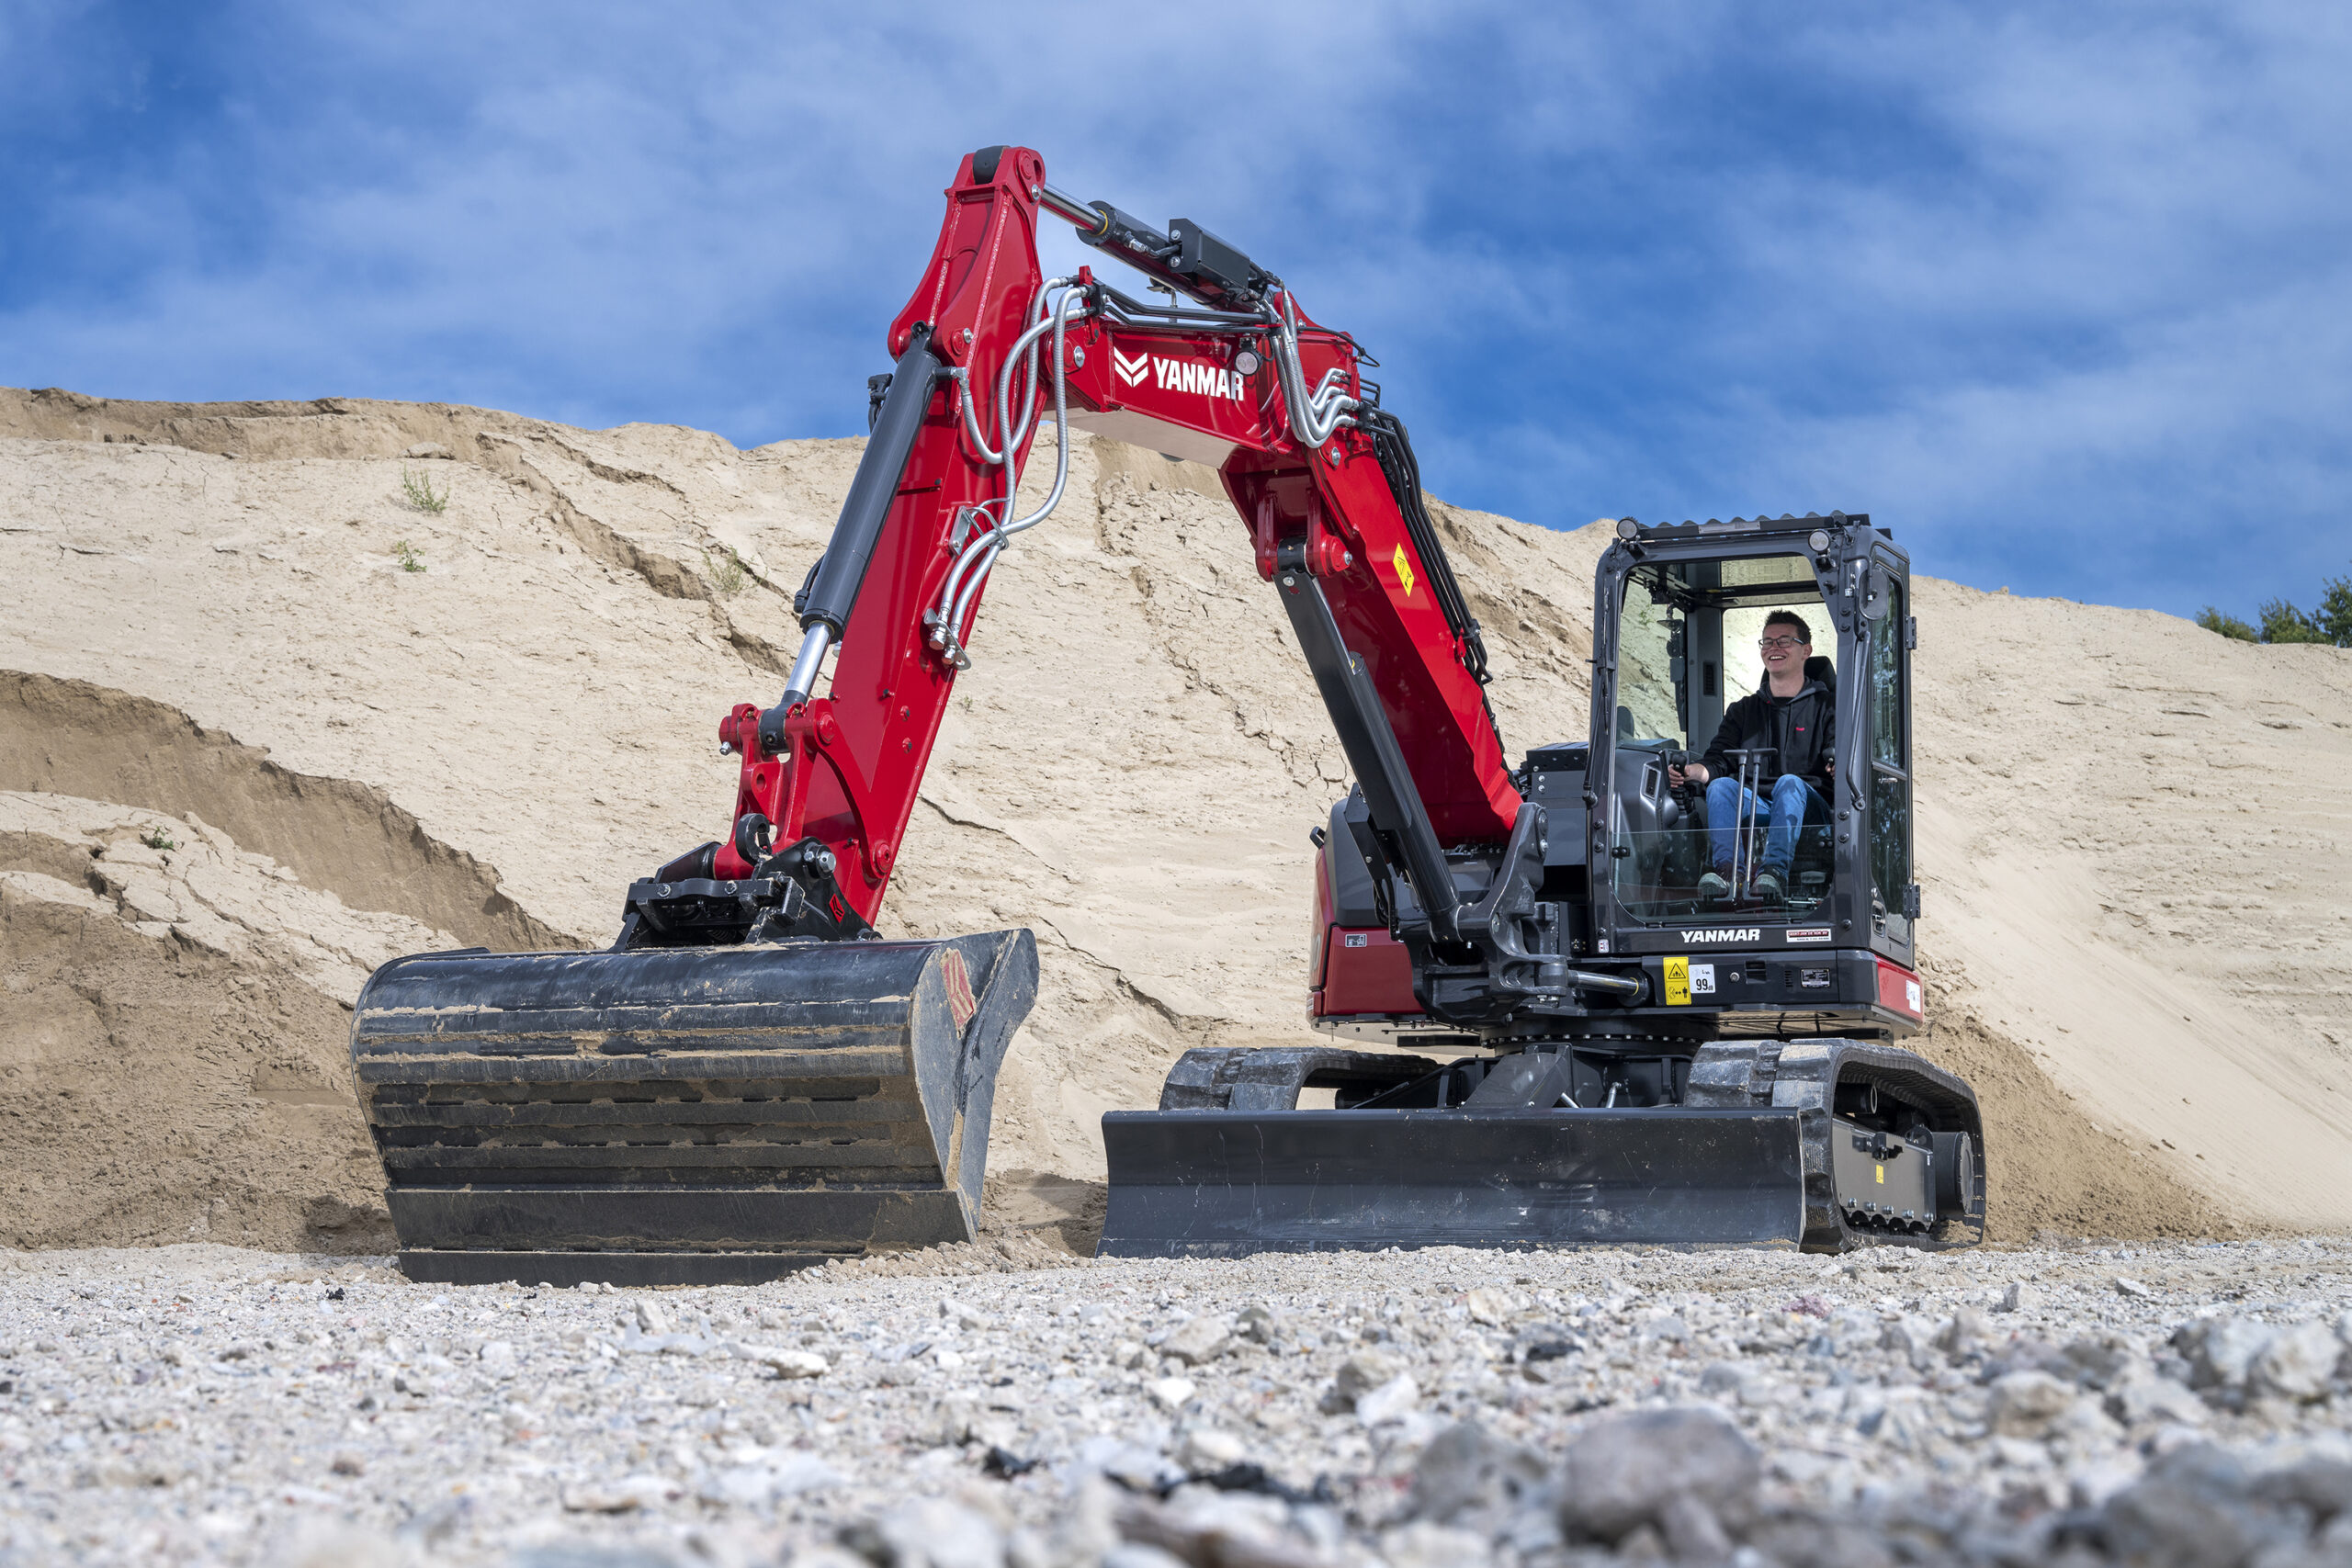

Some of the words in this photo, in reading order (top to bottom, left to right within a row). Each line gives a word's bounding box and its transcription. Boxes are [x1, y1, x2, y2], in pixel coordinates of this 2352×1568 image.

[1153, 356, 1244, 401] YANMAR
[1680, 929, 1761, 943] YANMAR
[1696, 978, 1708, 991] 99
